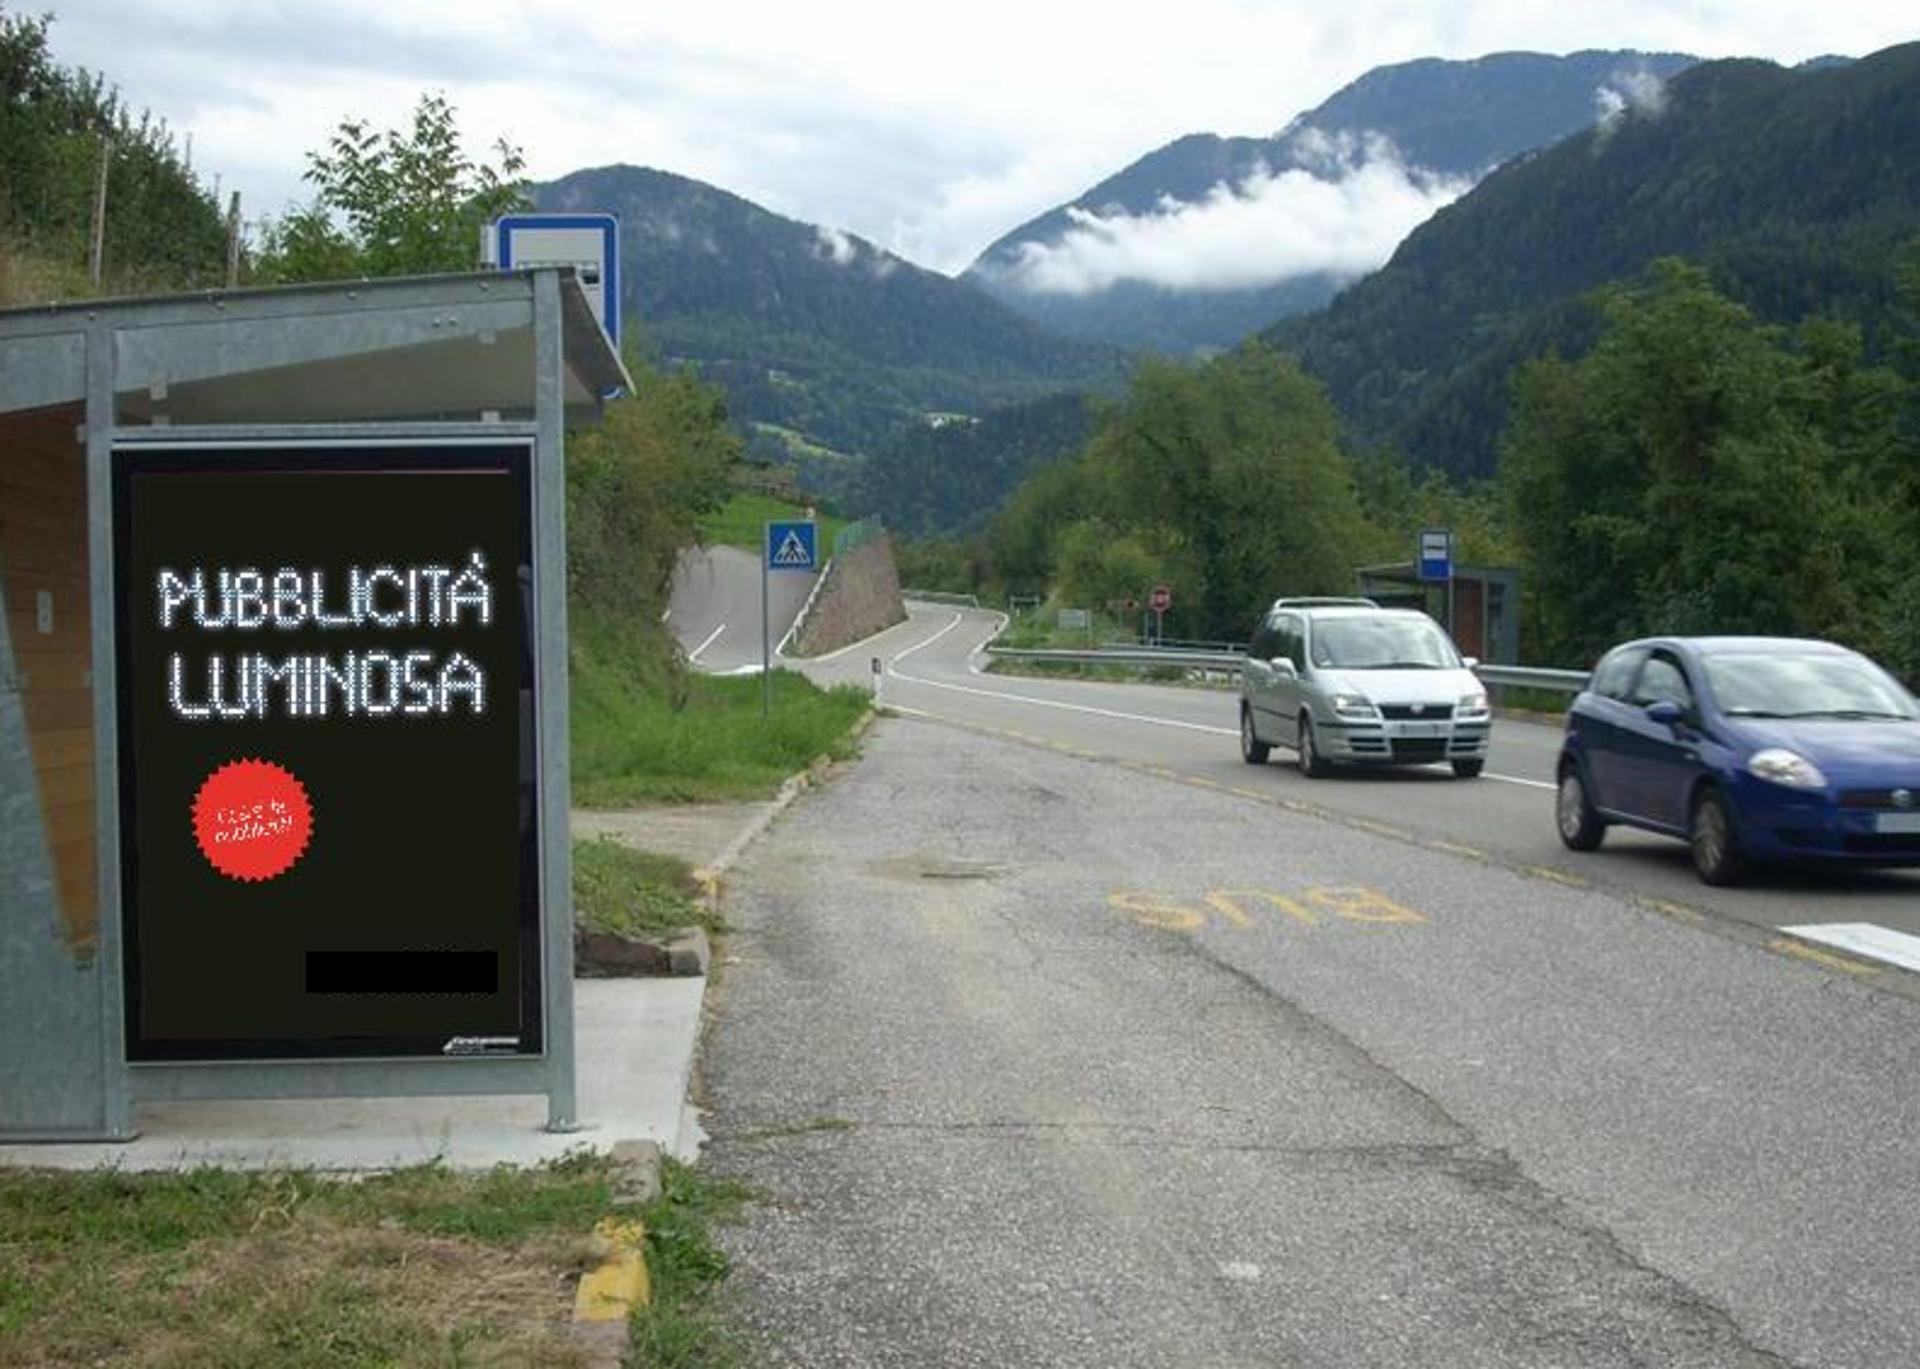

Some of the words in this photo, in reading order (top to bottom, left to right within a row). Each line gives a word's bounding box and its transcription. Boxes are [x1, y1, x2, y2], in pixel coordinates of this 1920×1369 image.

[158, 551, 490, 627] PUBBLICITÀ
[169, 651, 484, 718] LUMINOSA
[1107, 882, 1432, 933] BUS
